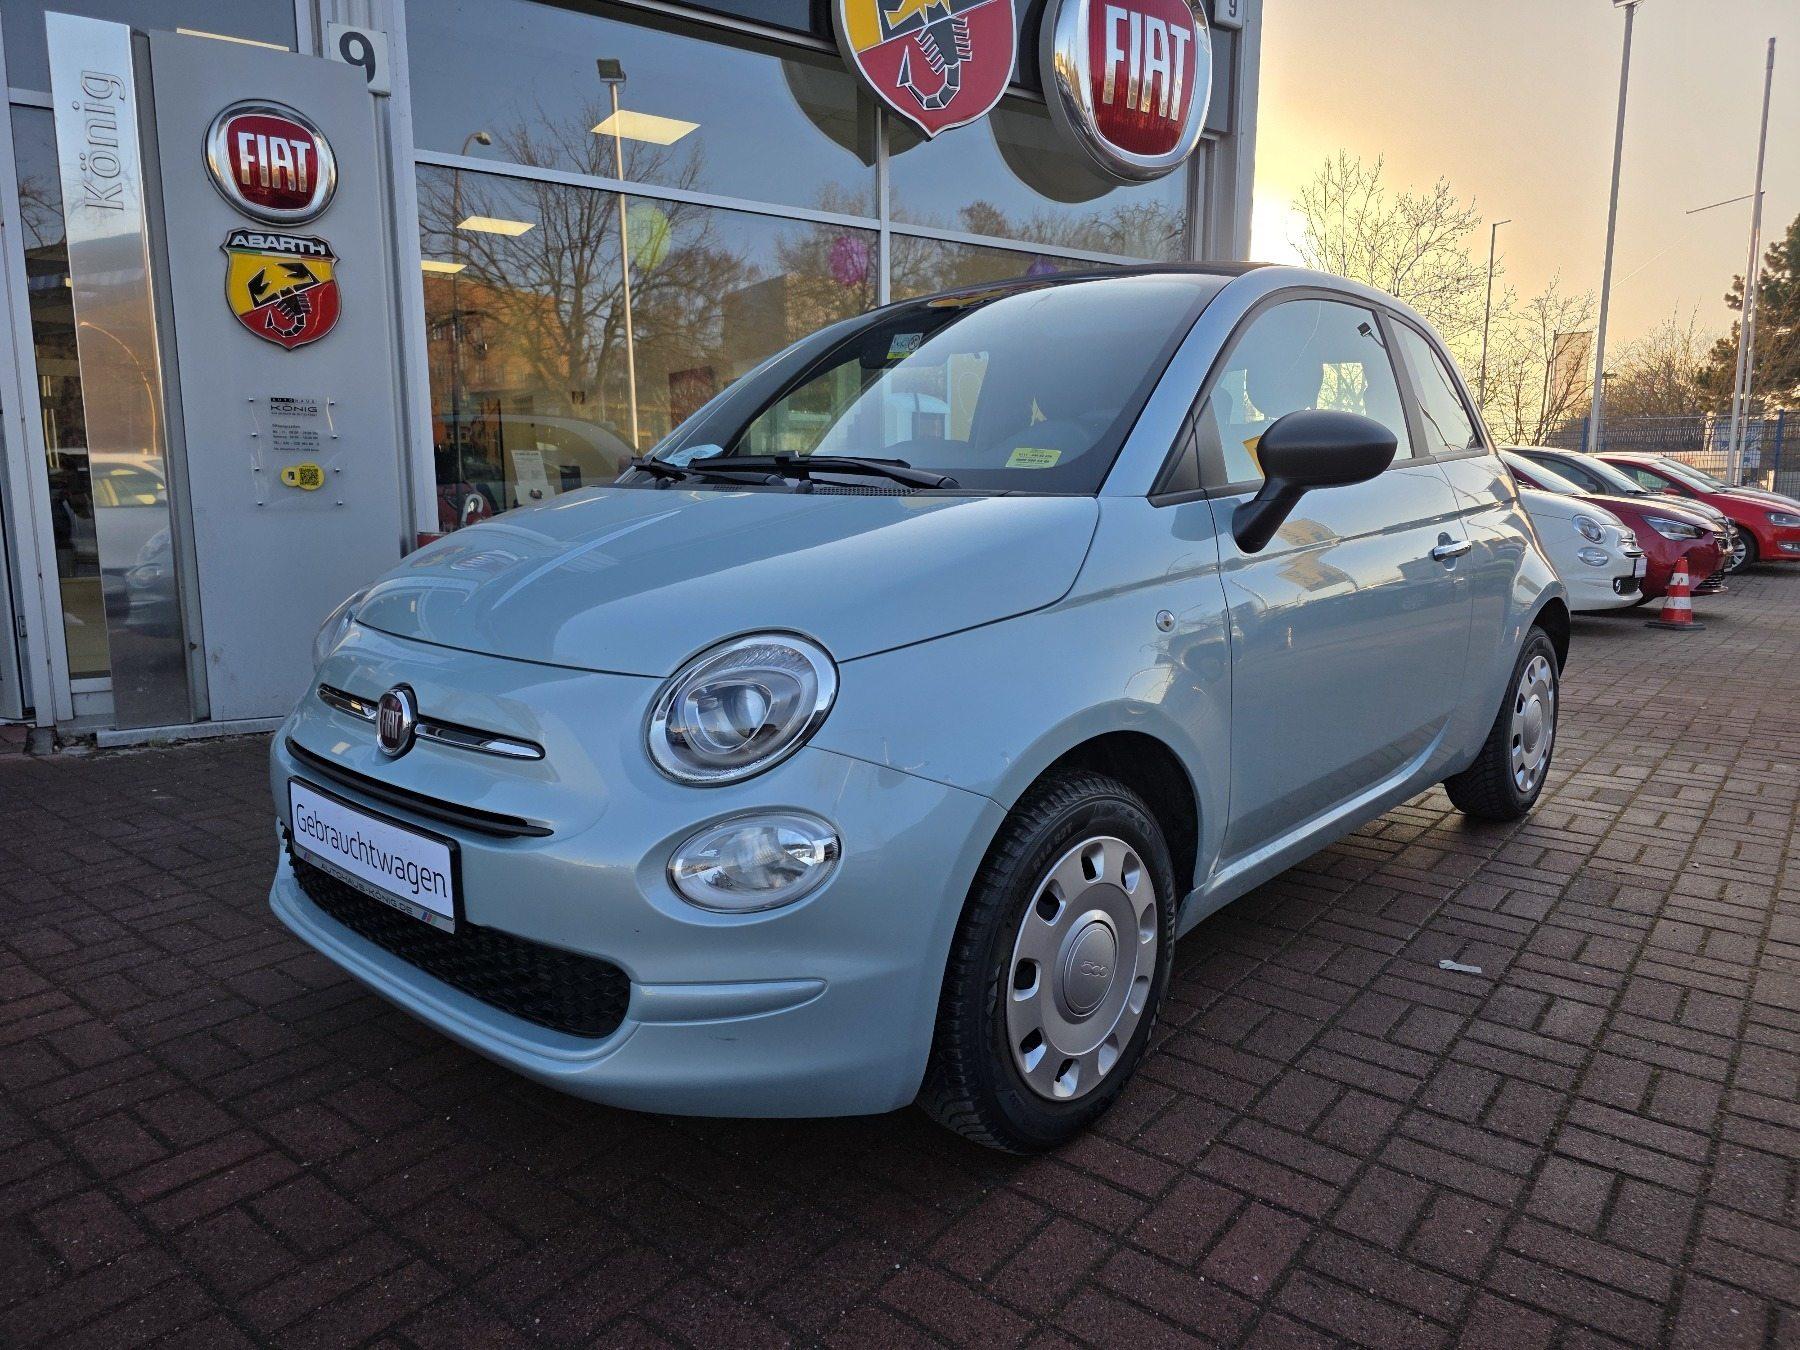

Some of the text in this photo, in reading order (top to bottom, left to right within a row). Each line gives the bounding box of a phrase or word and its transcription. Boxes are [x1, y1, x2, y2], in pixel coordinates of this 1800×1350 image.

[339, 31, 376, 83] 9
[1103, 4, 1191, 121] FIAT
[72, 70, 126, 211] König
[238, 132, 311, 192] FIAT
[231, 235, 326, 255] ABARTH
[381, 708, 402, 740] FIAT
[295, 803, 447, 898] Gebrauchtwagen
[320, 863, 414, 915] AUTOHAUS-KÖNIG.DE
